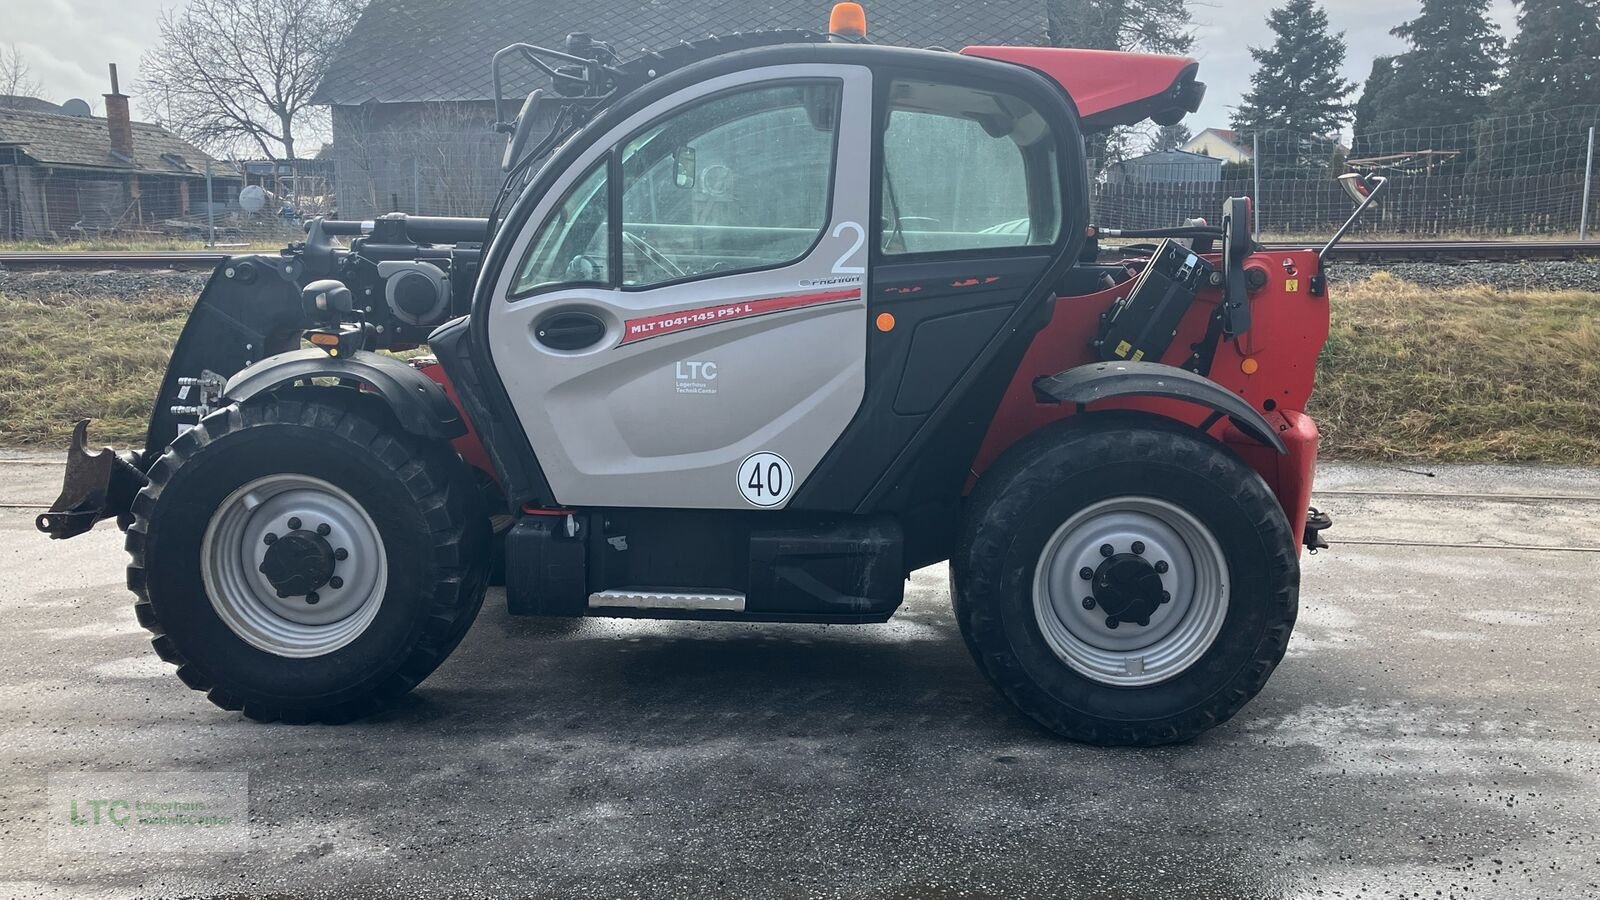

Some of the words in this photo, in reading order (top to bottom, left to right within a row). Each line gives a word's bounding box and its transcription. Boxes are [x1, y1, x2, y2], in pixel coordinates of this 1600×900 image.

[831, 221, 865, 273] 2
[631, 322, 656, 334] MLT
[658, 312, 715, 329] 1041-145
[717, 307, 741, 317] PS+
[745, 304, 753, 312] L
[676, 361, 717, 380] LTC
[748, 462, 782, 497] 40
